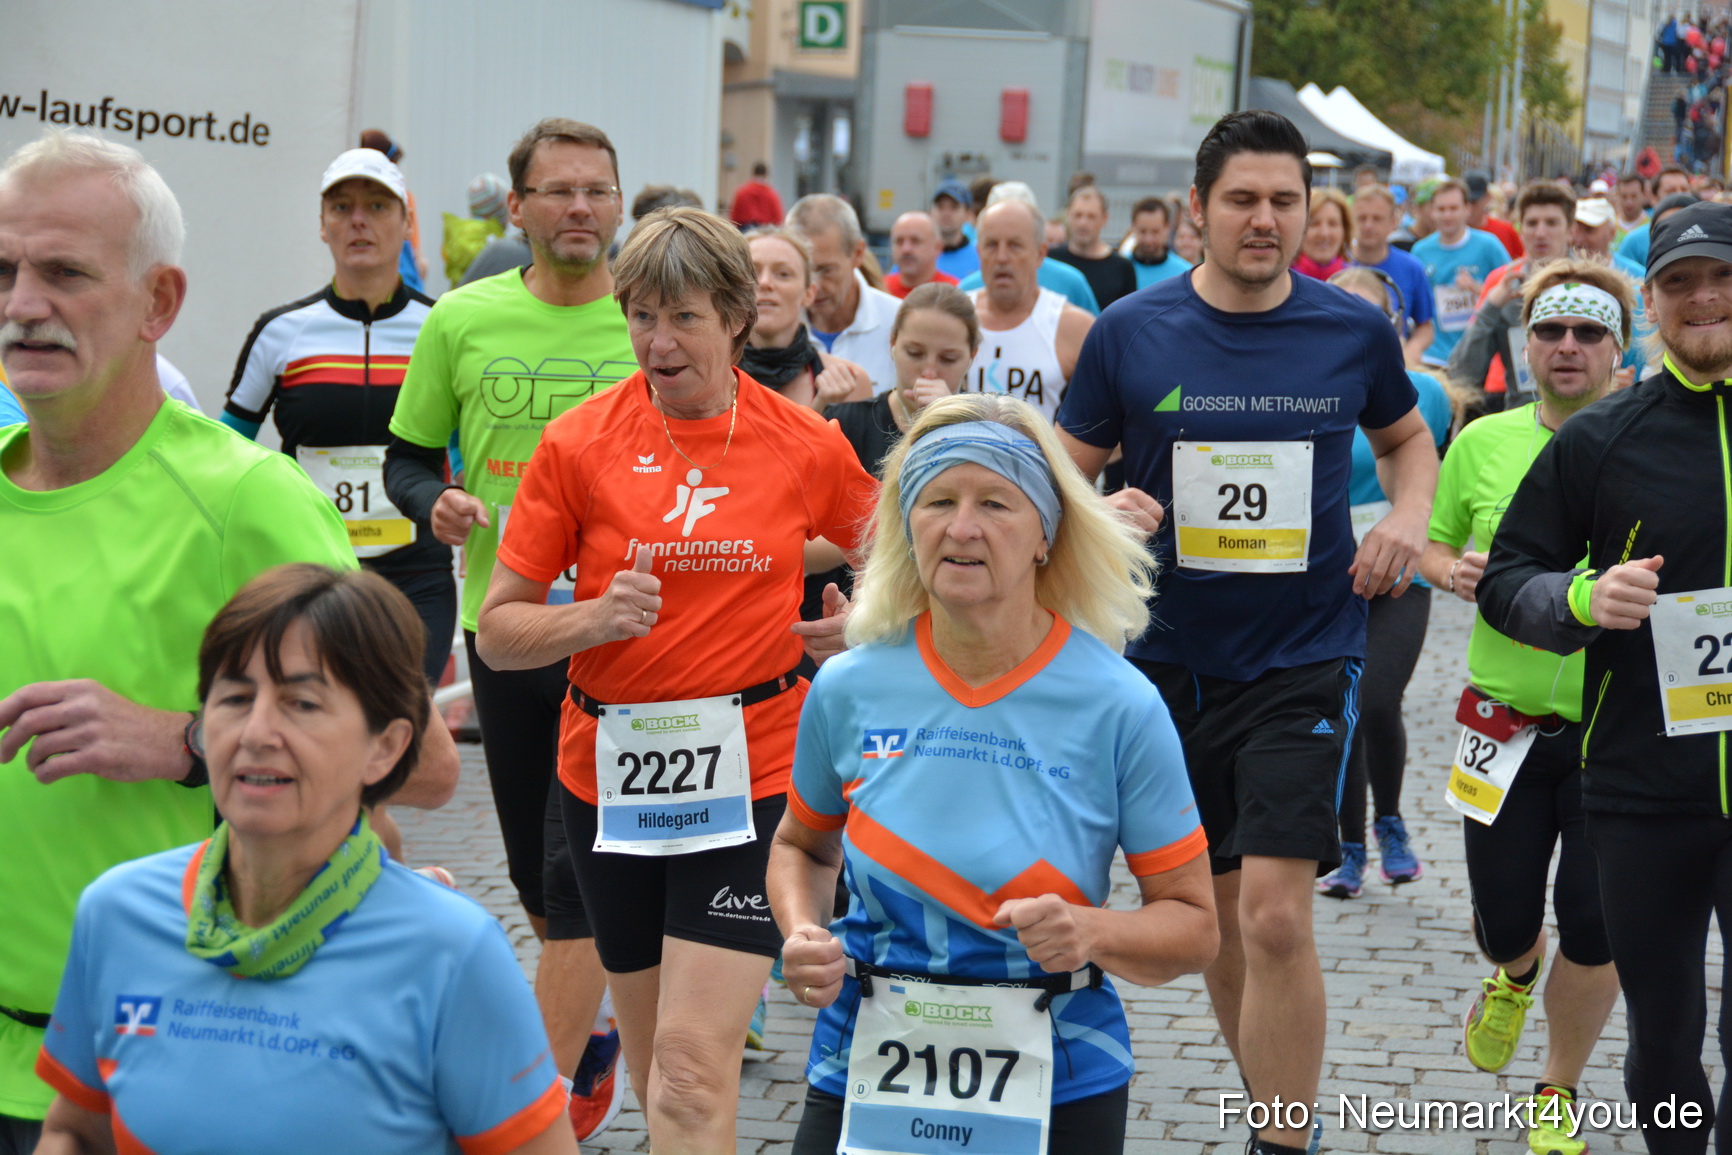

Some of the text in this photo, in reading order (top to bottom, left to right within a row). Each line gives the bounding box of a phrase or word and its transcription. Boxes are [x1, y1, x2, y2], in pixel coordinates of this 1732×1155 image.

[803, 4, 841, 44] D
[1183, 396, 1340, 413] GOSSEN METRAWATT
[633, 465, 662, 474] erima
[1225, 455, 1273, 466] BOCK
[335, 481, 369, 513] 81
[1218, 483, 1267, 521] 29
[347, 527, 382, 537] witha
[1218, 536, 1266, 549] Roman
[664, 554, 773, 572] neumarkt
[645, 714, 700, 730] BOCK
[916, 728, 1026, 751] Raiffeisenbank
[617, 745, 722, 795] 2227
[914, 745, 988, 762] Neumarkt
[1048, 765, 1070, 779] eG
[606, 791, 612, 799] D
[638, 808, 709, 830] Hildegard
[709, 886, 770, 909] live
[272, 880, 340, 941] neumarkt
[173, 999, 300, 1030] Raiffeisenbank
[922, 1002, 993, 1022] BOCK
[167, 1022, 254, 1046] Neumarkt
[328, 1044, 356, 1061] eG
[876, 1039, 1020, 1103] 2107
[857, 1084, 864, 1095] D
[910, 1117, 973, 1147] Conny
